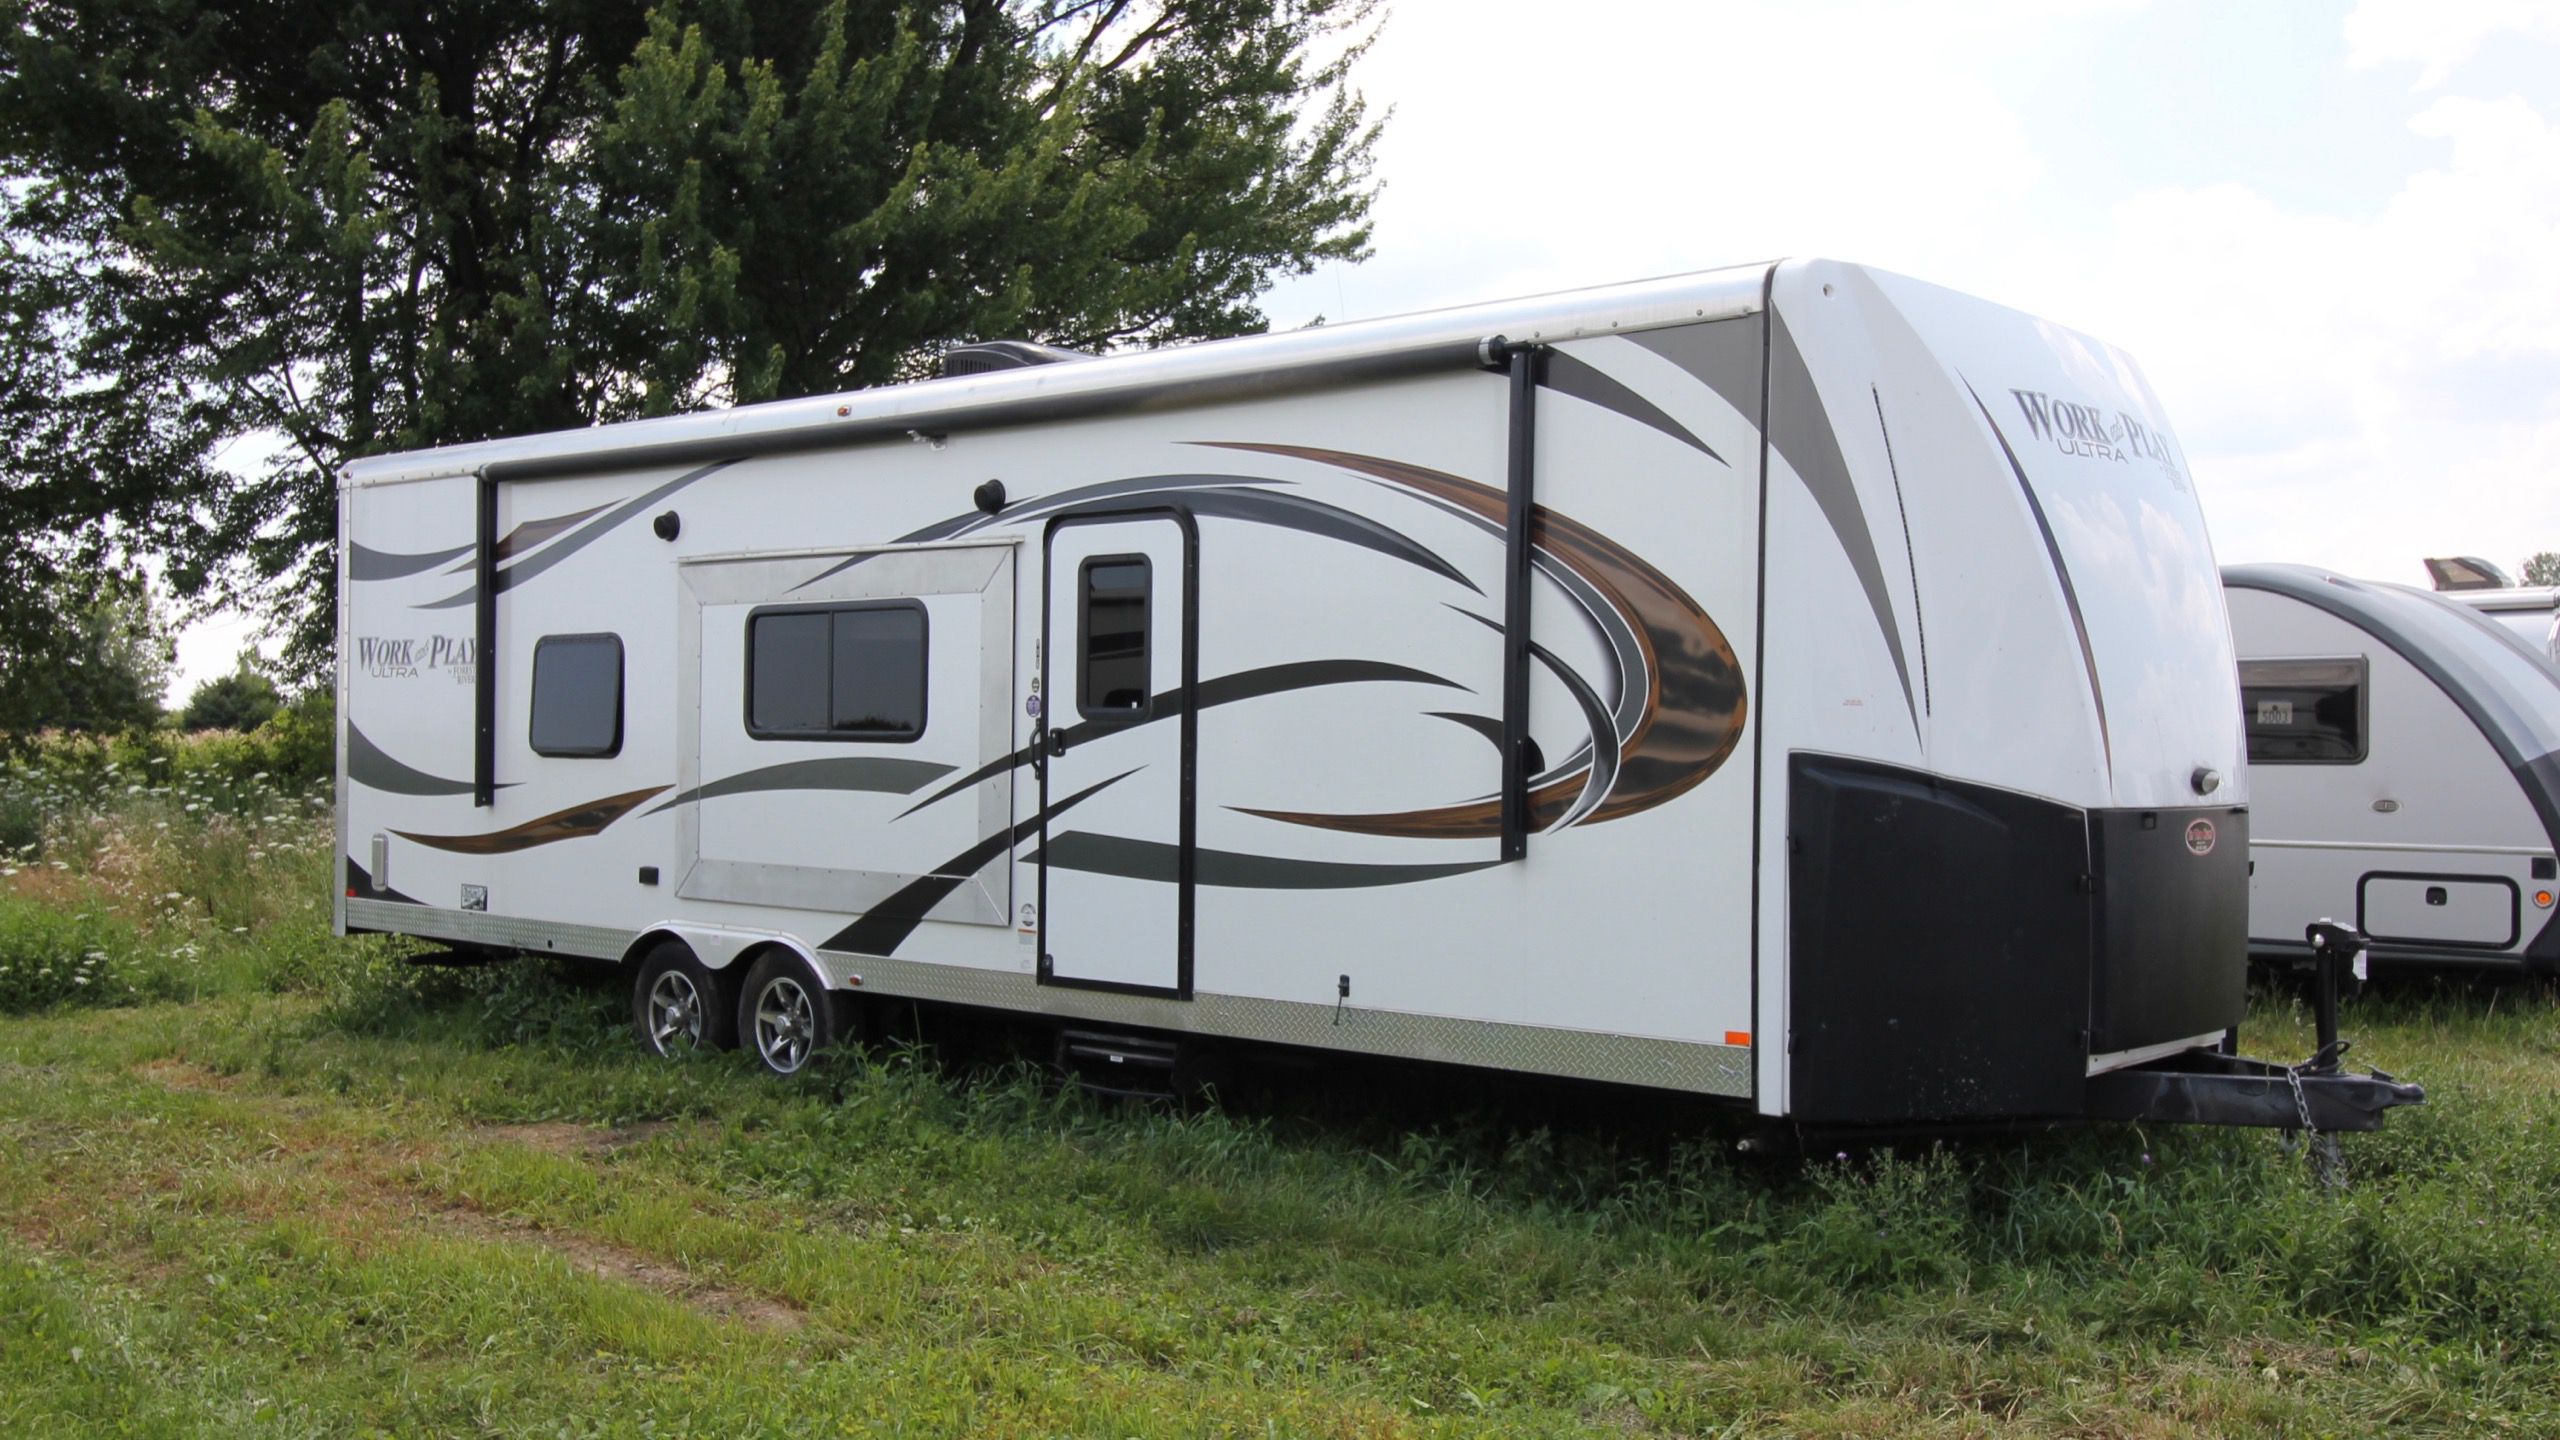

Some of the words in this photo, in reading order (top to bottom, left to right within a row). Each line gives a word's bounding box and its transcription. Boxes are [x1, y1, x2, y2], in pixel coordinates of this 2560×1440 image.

[2009, 388, 2111, 445] WORK
[2118, 411, 2175, 466] PLAY
[2057, 438, 2129, 464] ULTRA
[358, 637, 415, 670] WORK
[371, 667, 419, 678] ULTRA
